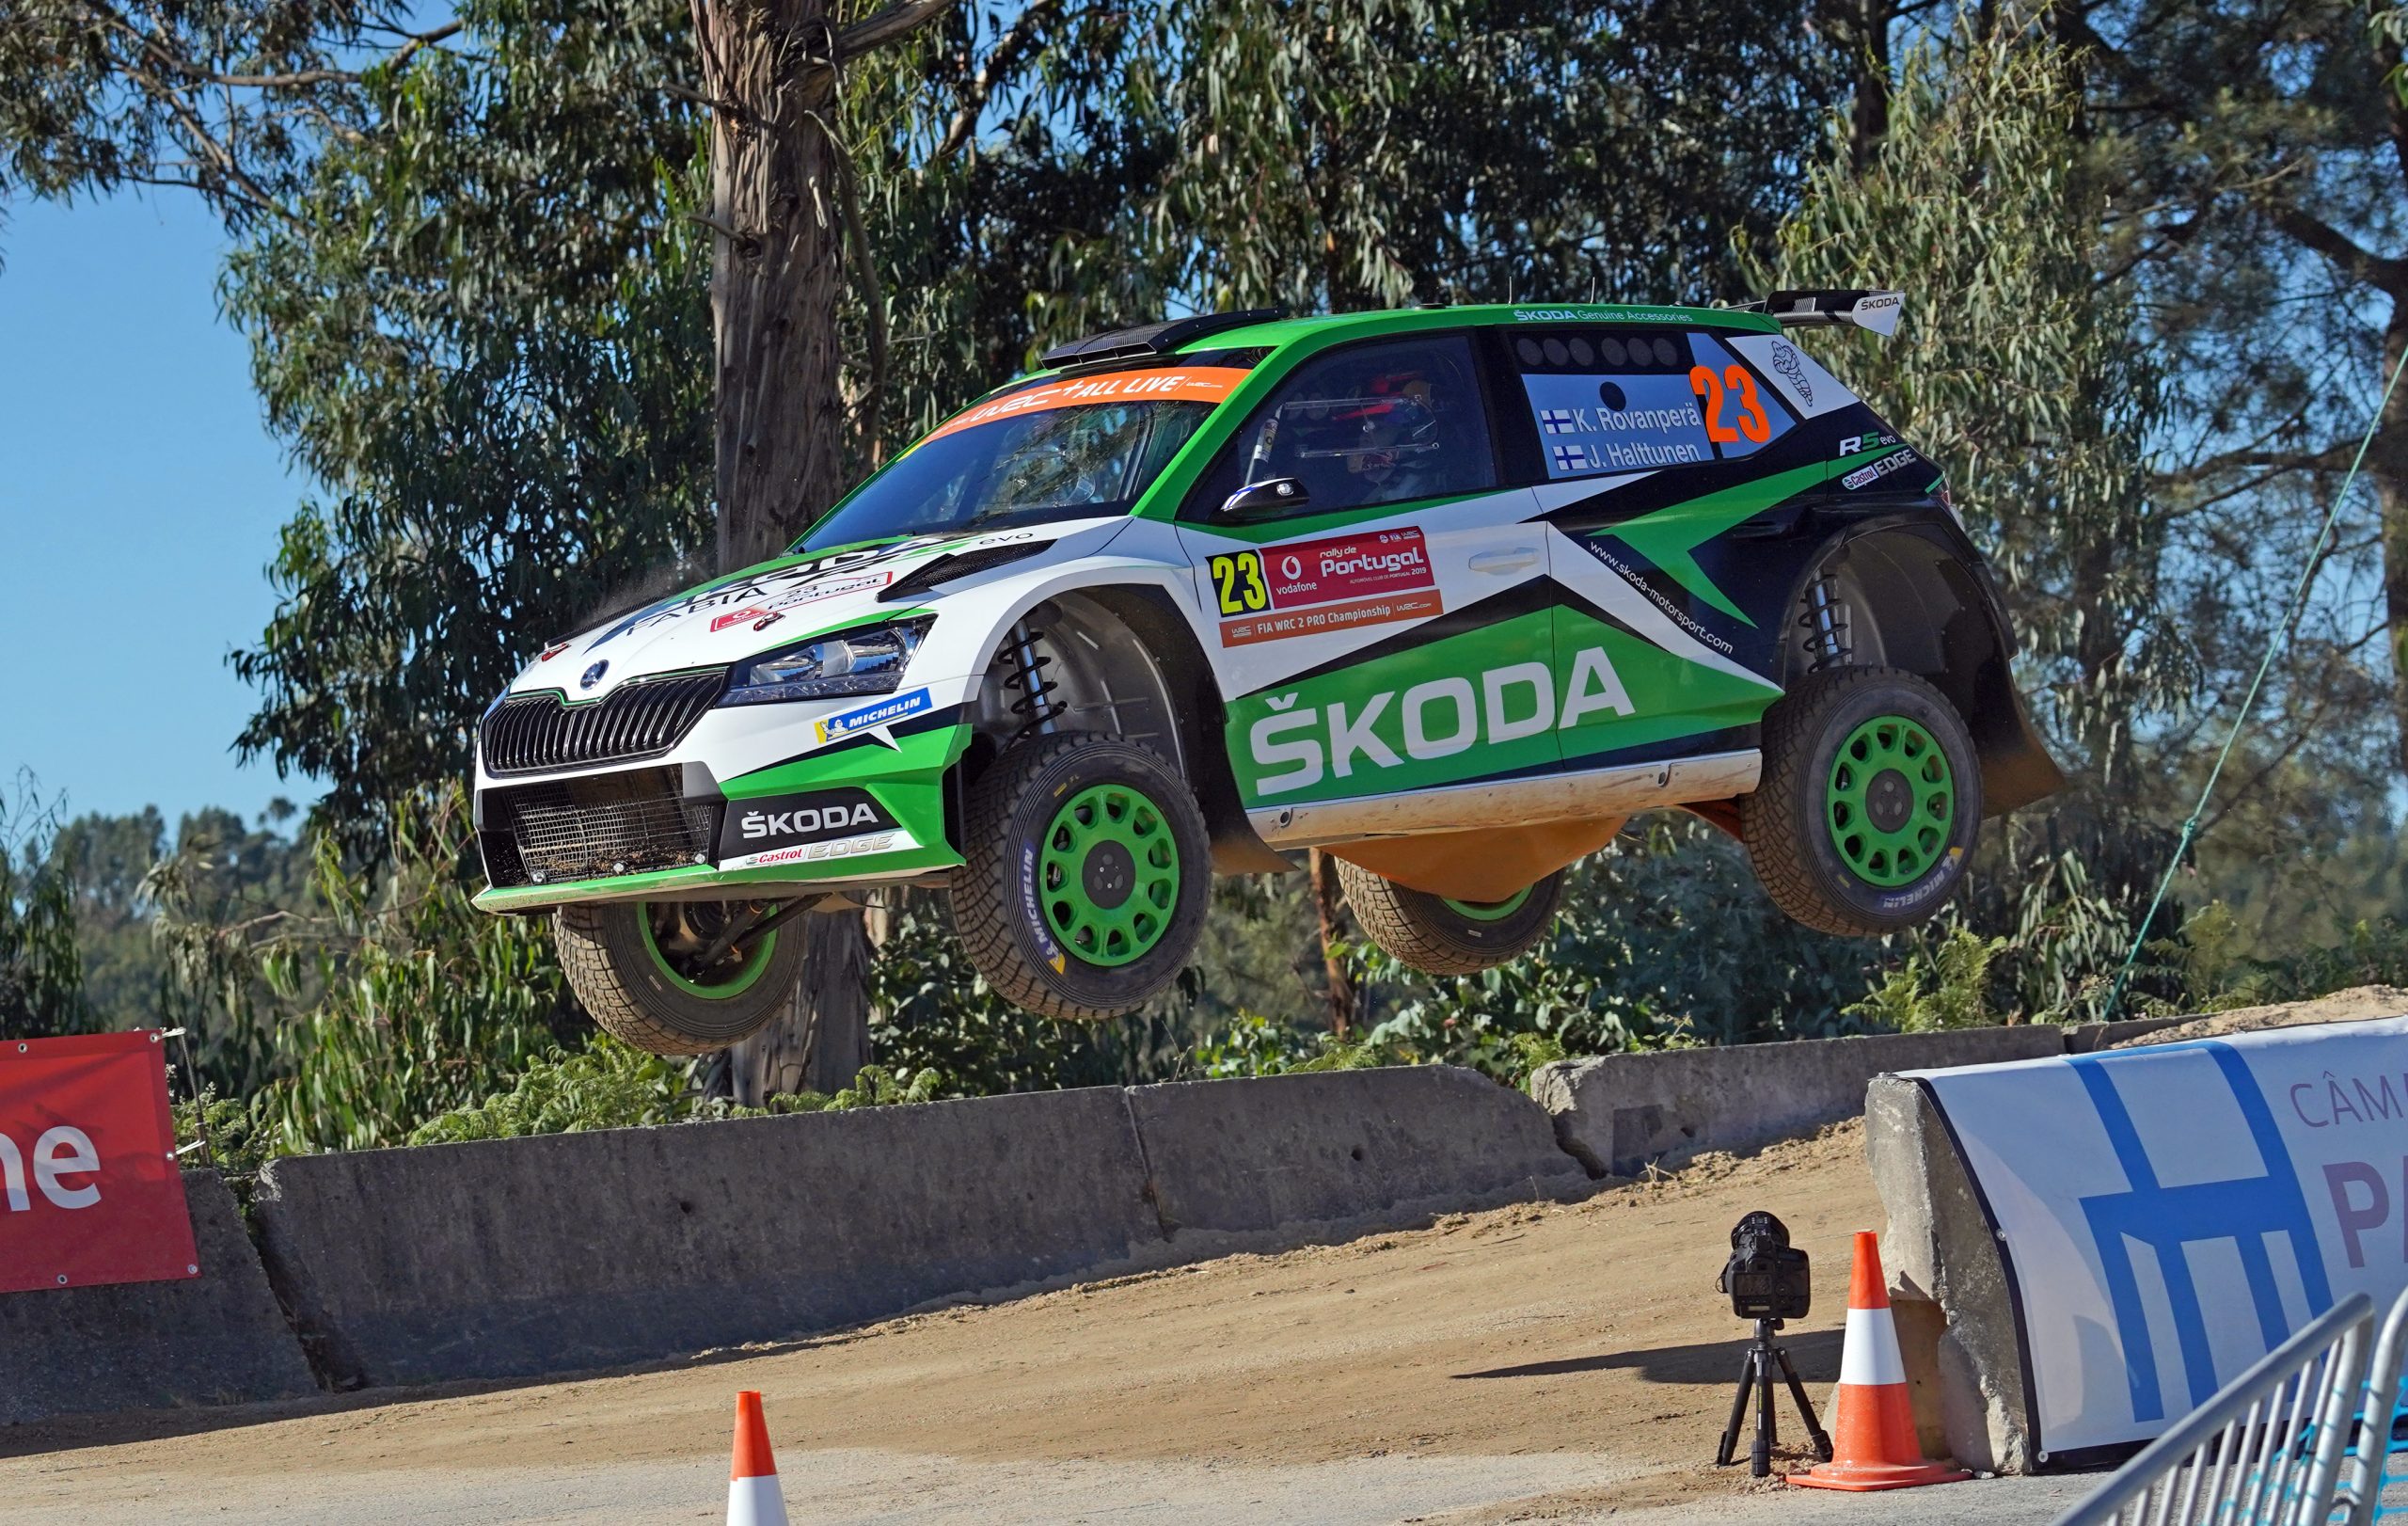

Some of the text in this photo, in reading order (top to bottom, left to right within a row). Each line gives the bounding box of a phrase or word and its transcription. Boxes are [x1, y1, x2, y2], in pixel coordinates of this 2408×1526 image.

[1513, 310, 1693, 322] ŠKODA Genuine Accessories
[1071, 379, 1121, 399] ALL
[1122, 376, 1185, 394] LIVE
[1573, 403, 1702, 434] K. Rovanperä
[1689, 364, 1770, 443] 23
[1589, 441, 1702, 469] J. Halttunen
[1850, 449, 1917, 485] Castrol EDGE
[979, 533, 1034, 547] evo
[1320, 547, 1356, 558] rally de
[1321, 547, 1424, 578] Portugal
[1411, 566, 1427, 576] 2019
[1212, 552, 1267, 612] 23
[1276, 582, 1317, 596] vodafone
[626, 587, 768, 636] FABIA
[1591, 541, 1734, 655] www.skoda-motorsport.com
[1257, 623, 1273, 635] FIA
[1275, 619, 1296, 631] WRC
[1298, 617, 1305, 628] 2
[1307, 614, 1325, 626] PRO
[1327, 605, 1391, 624] Championship
[848, 696, 921, 727] MICHELIN
[1249, 645, 1636, 797] ŠKODA
[741, 803, 879, 839] ŠKODA
[758, 833, 895, 864] Castrol EDGE
[1022, 848, 1048, 944] MICHELIN
[1883, 870, 1945, 909] MICHELIN
[2289, 1071, 2408, 1128] CÂM
[2322, 1155, 2408, 1268] P
